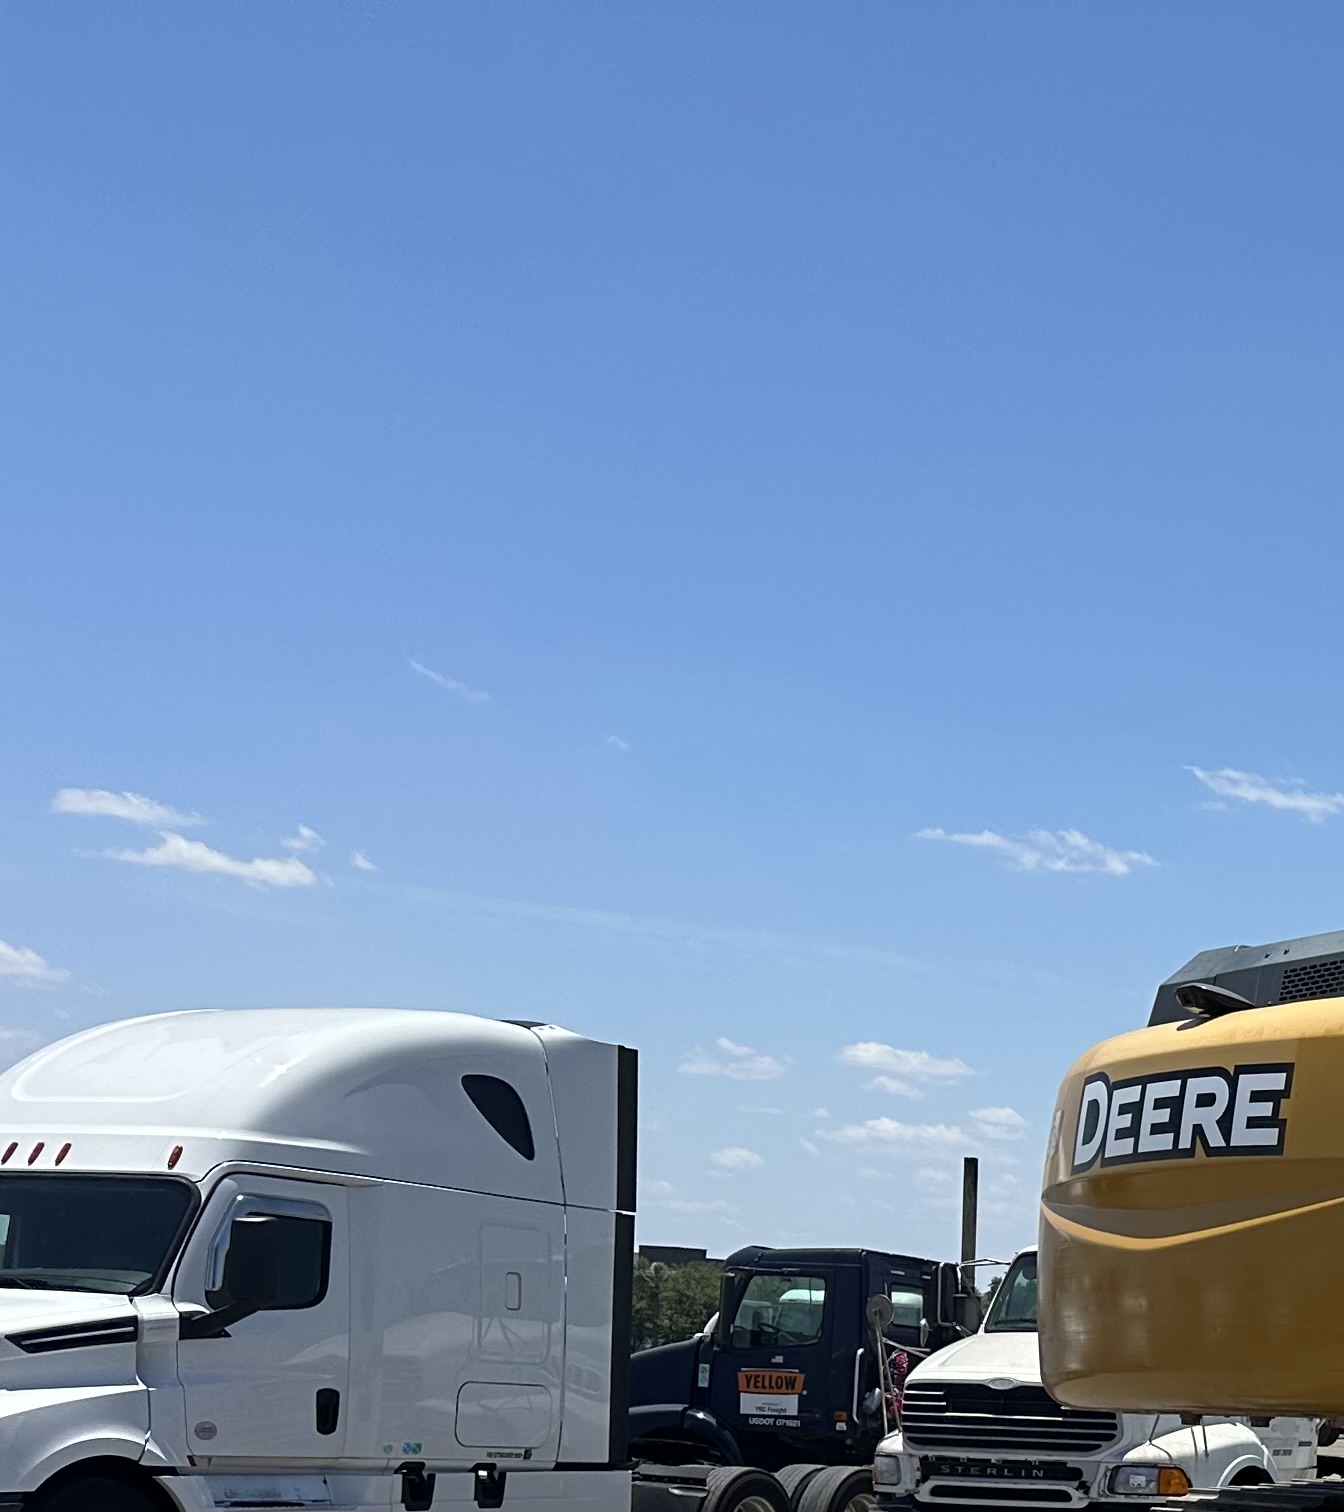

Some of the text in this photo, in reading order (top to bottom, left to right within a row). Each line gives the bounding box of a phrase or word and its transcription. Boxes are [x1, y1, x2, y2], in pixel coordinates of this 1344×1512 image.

[1073, 1071, 1288, 1167] DEERE
[744, 1374, 797, 1391] YELLOW
[940, 1465, 1044, 1478] STERLIN
